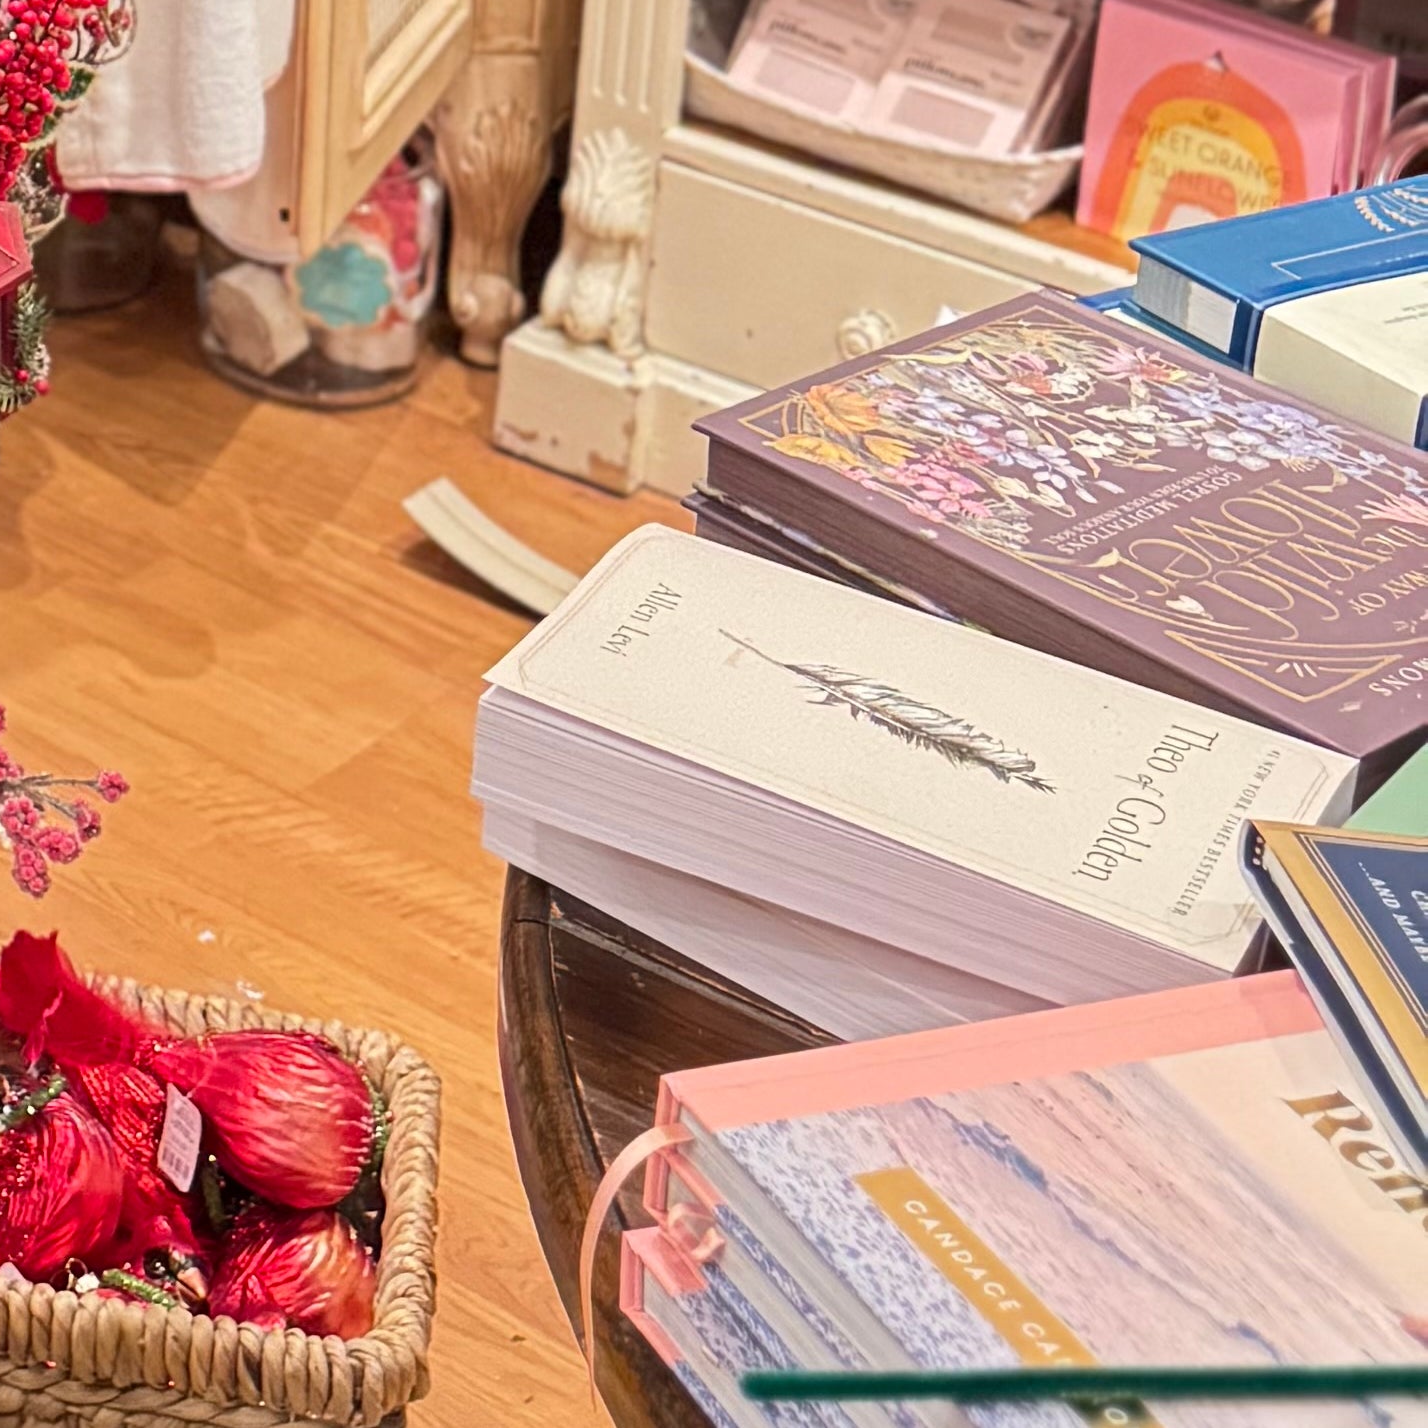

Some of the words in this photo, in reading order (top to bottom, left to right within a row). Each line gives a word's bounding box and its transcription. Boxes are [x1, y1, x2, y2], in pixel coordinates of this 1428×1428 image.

[1172, 471, 1243, 503] GOSPEL
[1056, 499, 1180, 556] MEDITATIONS
[629, 582, 683, 623] Allen
[1348, 592, 1388, 616] OF
[599, 624, 650, 657] Levi
[1146, 724, 1220, 774] Theo
[1113, 772, 1165, 798] of
[1254, 760, 1276, 783] NEW
[1235, 783, 1263, 812] YORK
[1213, 813, 1242, 848] TIMES
[1169, 847, 1223, 917] BESTSELLER
[903, 1198, 1022, 1313] CANDACE
